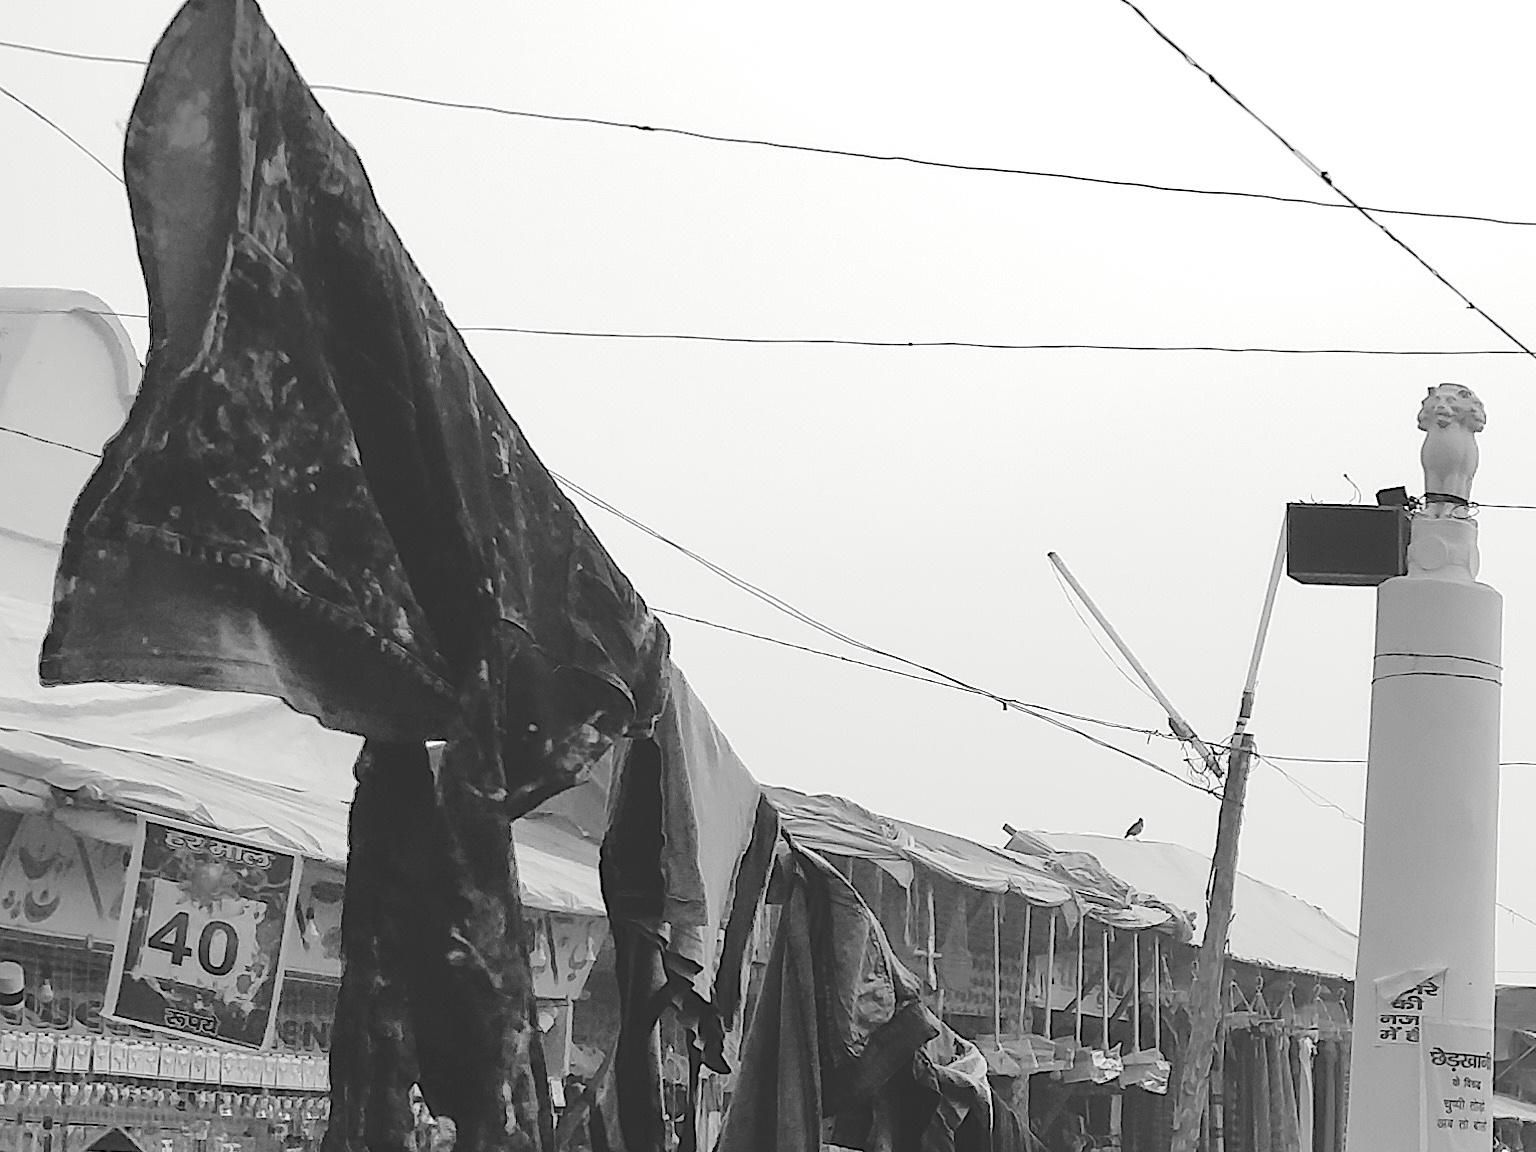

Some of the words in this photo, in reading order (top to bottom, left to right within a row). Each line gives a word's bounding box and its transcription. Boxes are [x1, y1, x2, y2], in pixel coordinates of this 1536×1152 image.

[167, 831, 207, 858] हर
[208, 840, 273, 871] माल
[147, 910, 241, 977] 40
[1391, 996, 1423, 1011] की
[1380, 1014, 1419, 1027] नज
[1380, 1027, 1402, 1041] में
